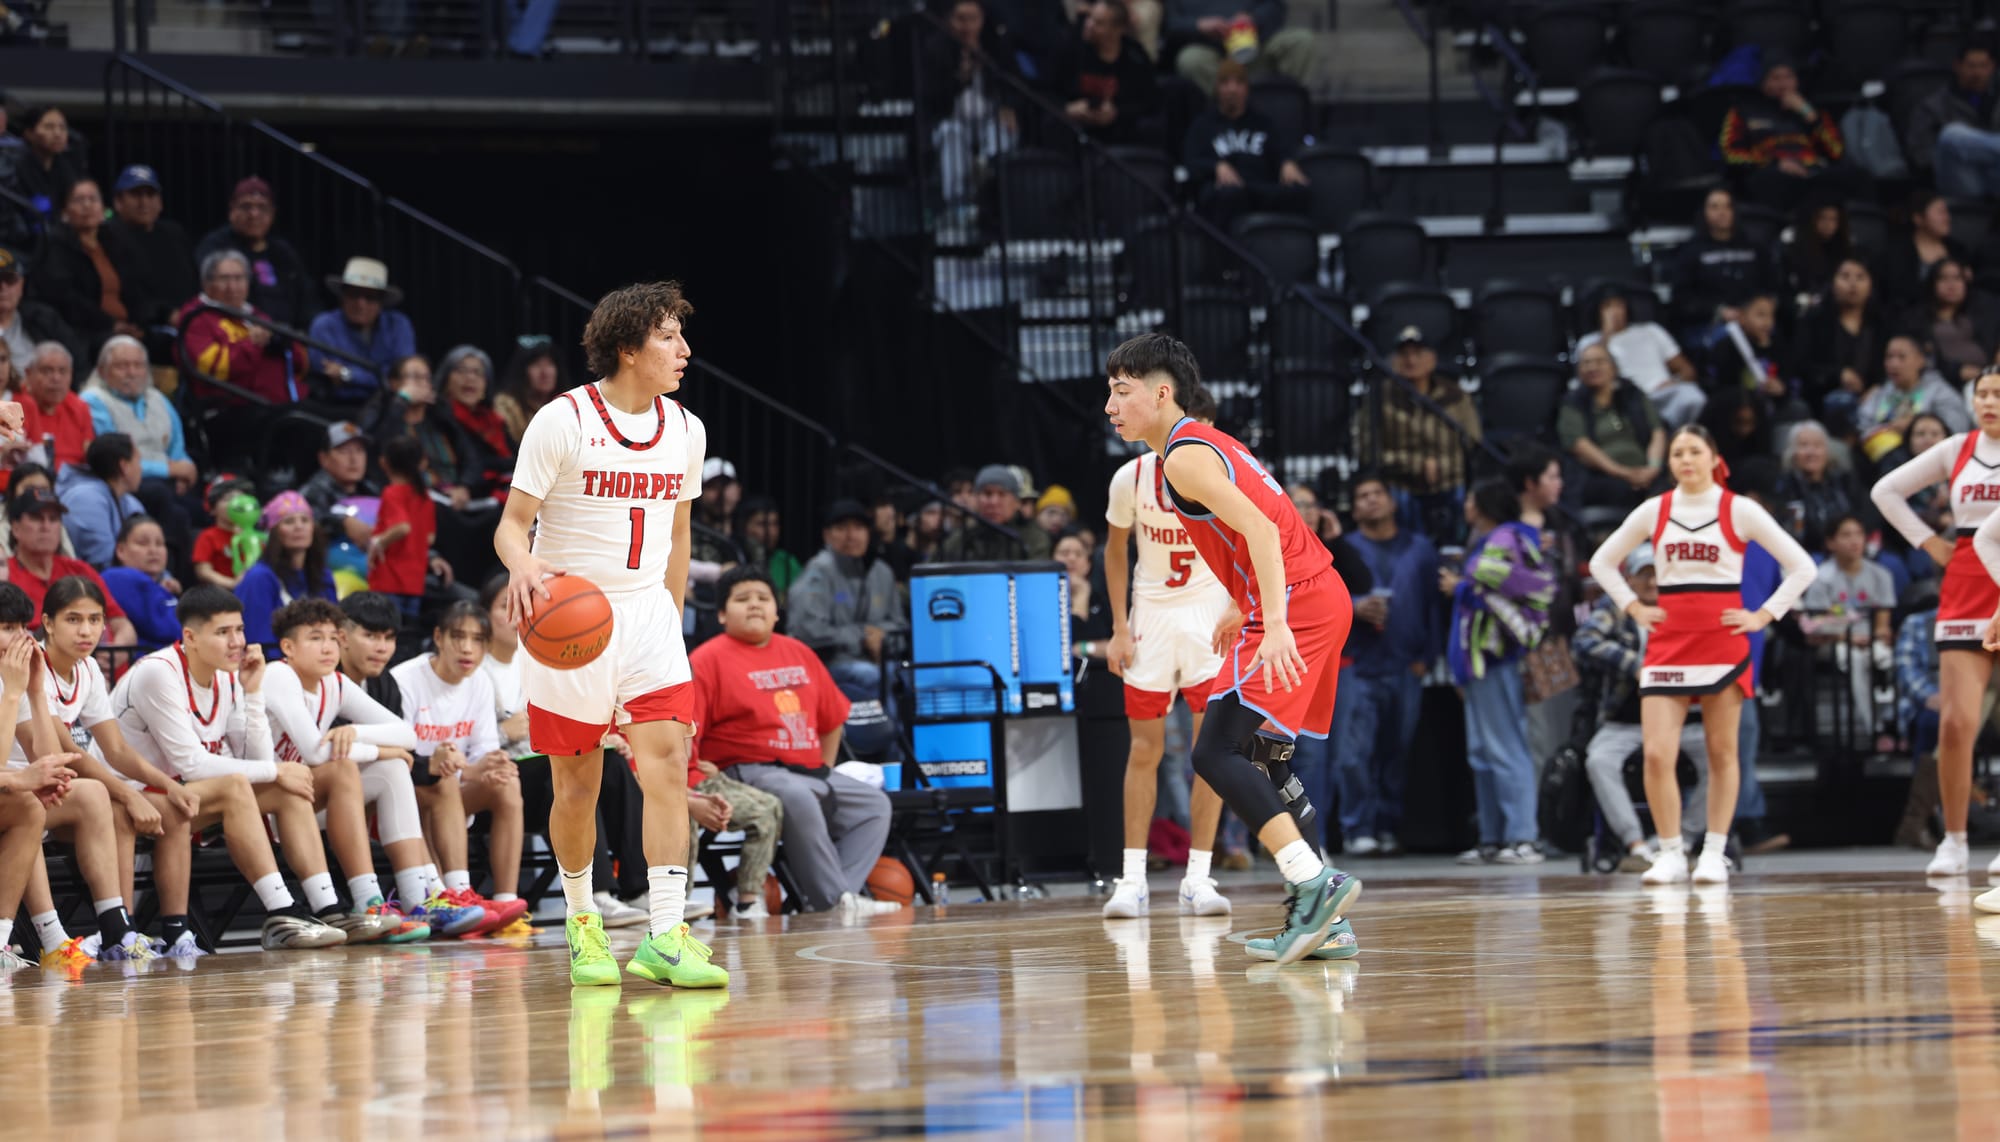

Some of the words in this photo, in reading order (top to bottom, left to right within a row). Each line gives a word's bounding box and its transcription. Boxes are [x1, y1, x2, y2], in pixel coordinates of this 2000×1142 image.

[1960, 484, 2000, 503] PRH
[627, 507, 645, 570] 1
[1141, 522, 1190, 545] THOR
[1664, 542, 1720, 563] PRHS
[1165, 551, 1196, 588] 5
